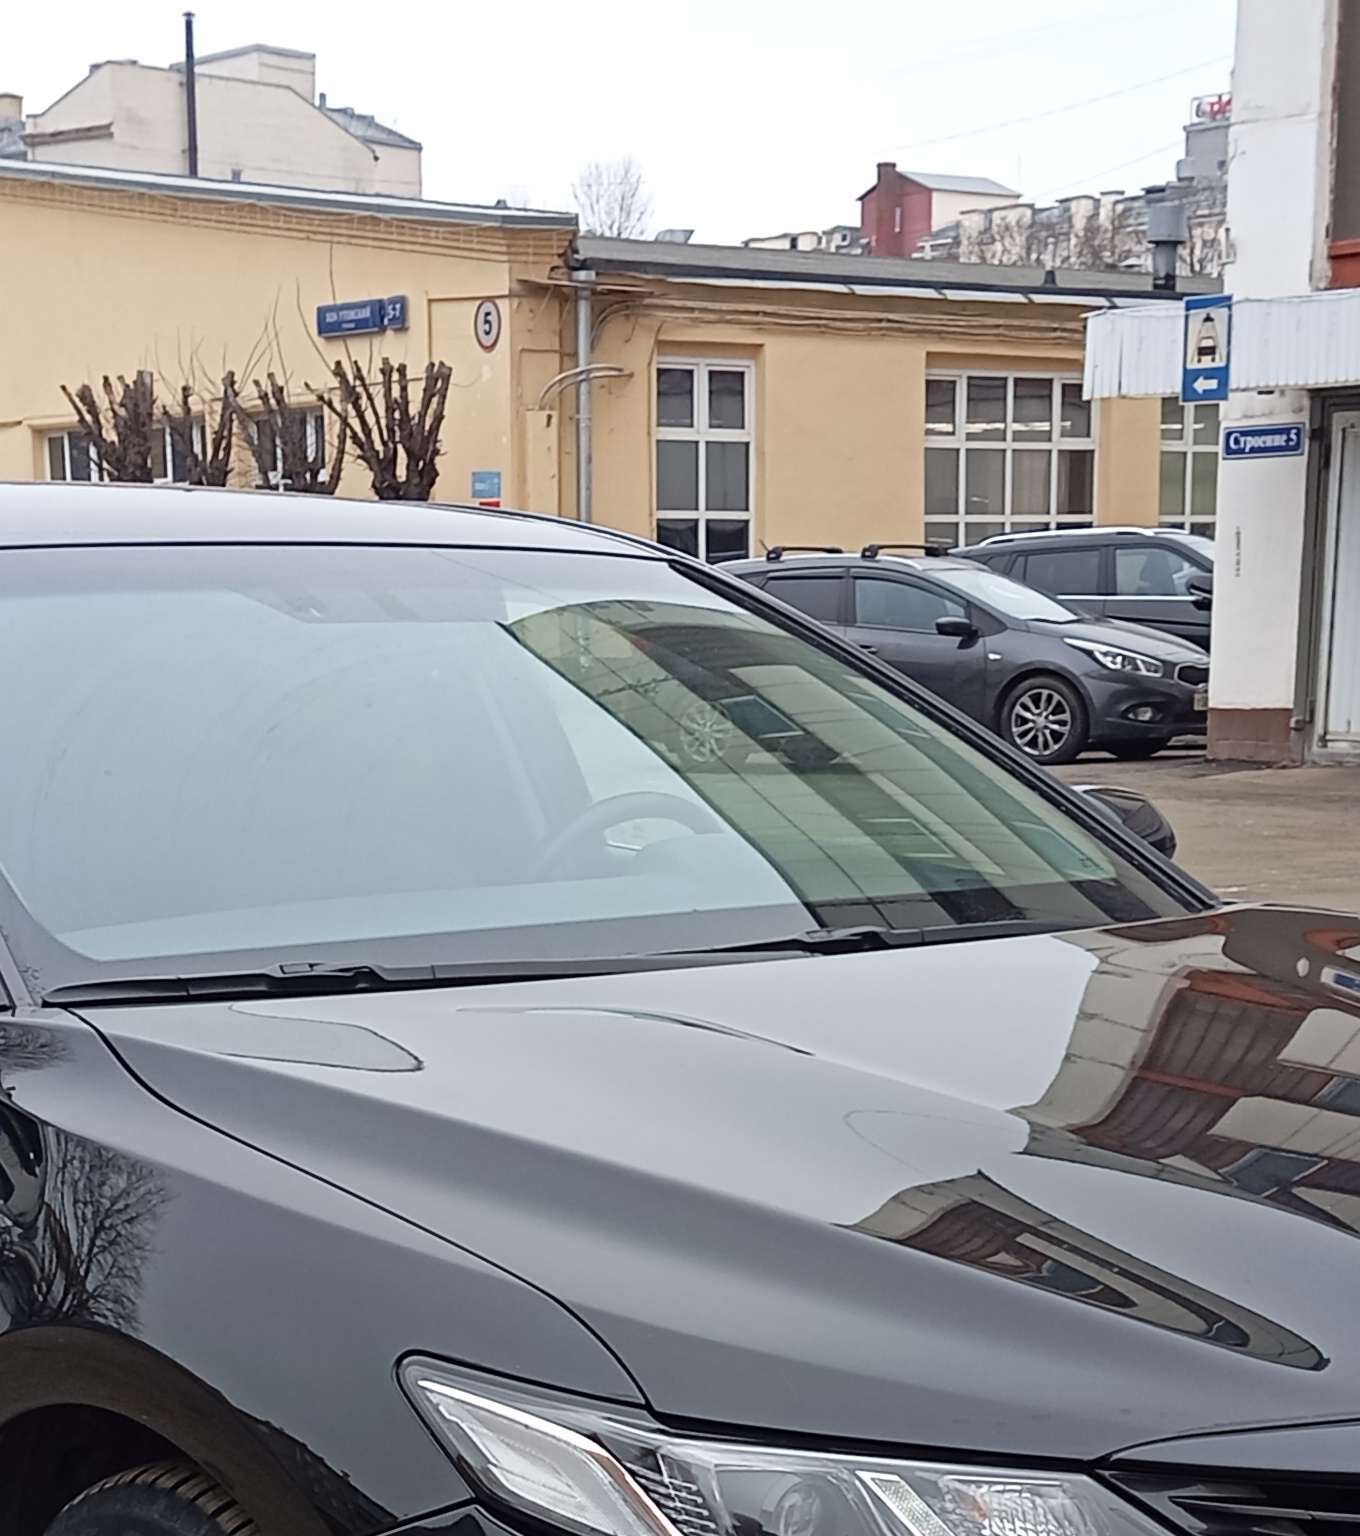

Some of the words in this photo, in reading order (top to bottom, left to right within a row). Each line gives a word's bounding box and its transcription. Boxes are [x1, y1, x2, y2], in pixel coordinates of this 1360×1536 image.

[483, 311, 492, 336] 5
[1229, 432, 1288, 453] Строение
[1288, 428, 1298, 446] 5
